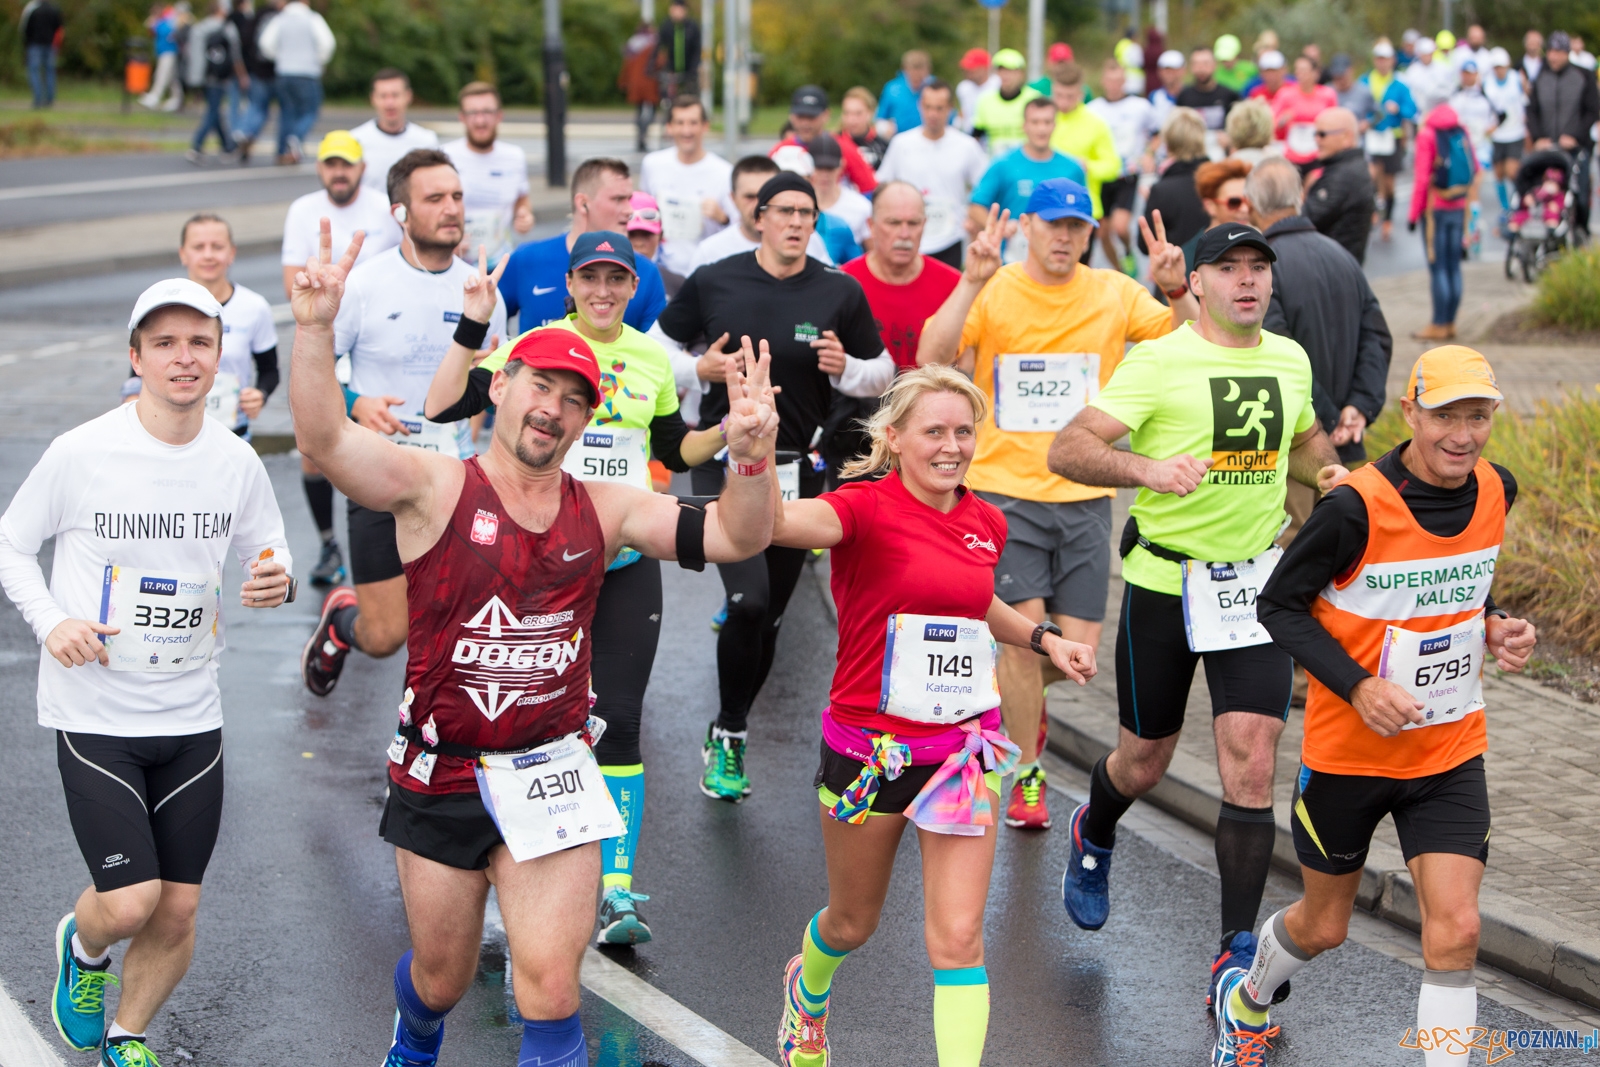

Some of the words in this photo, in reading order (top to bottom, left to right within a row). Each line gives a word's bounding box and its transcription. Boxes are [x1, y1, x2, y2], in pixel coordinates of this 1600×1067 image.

[1017, 380, 1071, 397] 5422
[586, 436, 596, 444] 17.
[596, 437, 611, 445] PKO
[583, 457, 628, 476] 5169
[1227, 451, 1269, 470] night
[1209, 470, 1276, 484] runners
[477, 508, 498, 519] POLSKA
[94, 512, 185, 540] RUNNING
[192, 512, 232, 539] TEAM
[1221, 569, 1235, 577] PKO
[143, 581, 155, 591] 17.
[156, 583, 174, 592] PKO
[1415, 585, 1476, 608] KALISZ
[134, 604, 203, 629] 3328
[521, 610, 574, 626] GRODZISK
[143, 633, 193, 645] Krzysztof
[928, 628, 939, 637] 17.
[939, 629, 955, 638] PKO
[451, 627, 584, 677] DOGON
[1423, 643, 1433, 652] 17.
[1433, 640, 1449, 650] PKO
[927, 653, 973, 678] 1149
[1415, 653, 1471, 688] 6793
[926, 682, 972, 694] Katarzyna
[1428, 685, 1458, 700] Marek
[481, 747, 530, 756] performance
[526, 769, 585, 801] 4301
